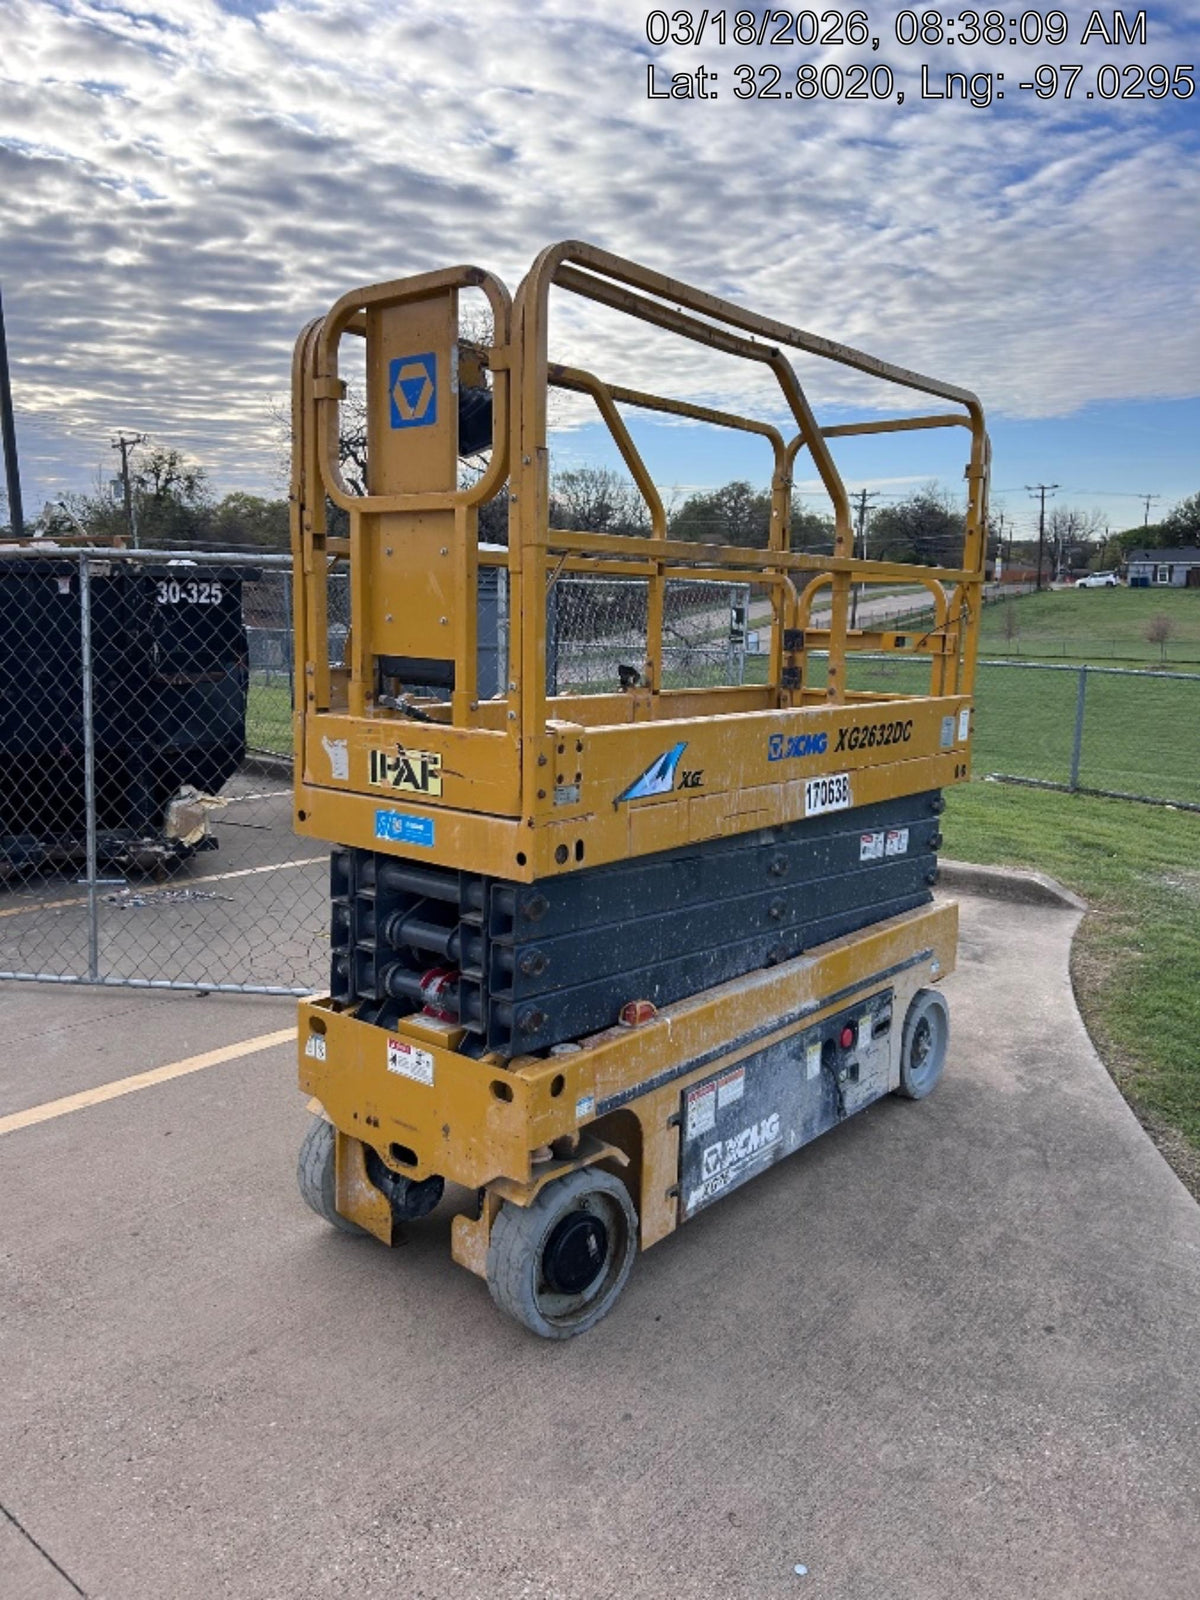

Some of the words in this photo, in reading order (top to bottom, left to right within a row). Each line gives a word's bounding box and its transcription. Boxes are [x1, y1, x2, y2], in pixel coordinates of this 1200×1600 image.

[156, 581, 223, 605] 30-325
[833, 719, 914, 753] XG2632DC
[677, 769, 705, 790] XG
